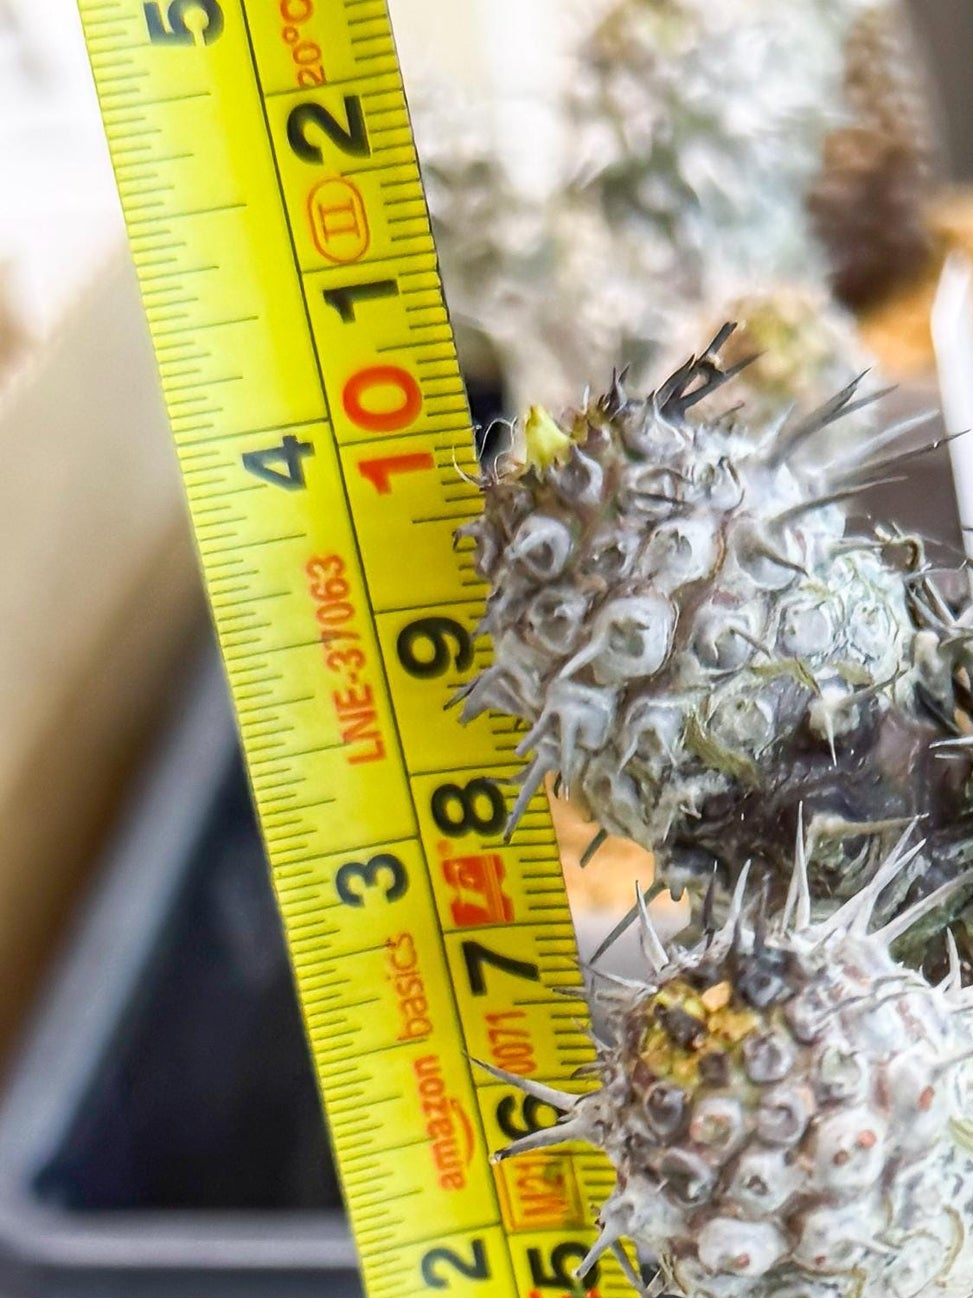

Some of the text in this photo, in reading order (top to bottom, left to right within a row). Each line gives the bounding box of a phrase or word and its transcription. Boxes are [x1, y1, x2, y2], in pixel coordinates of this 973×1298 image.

[145, 0, 225, 47] 5
[286, 94, 372, 165] 2
[322, 278, 400, 325] 1
[342, 364, 435, 496] 10
[242, 434, 315, 492] 4
[305, 552, 387, 766] LNE-37063
[396, 616, 475, 680] 9
[430, 777, 507, 838] 8
[335, 853, 409, 908] 3
[461, 940, 542, 997] 7
[386, 931, 468, 1192] amazon basics
[484, 1010, 537, 1074] 0071
[496, 1093, 564, 1141] 6
[420, 1237, 492, 1290] 2
[526, 1240, 600, 1290] 5
